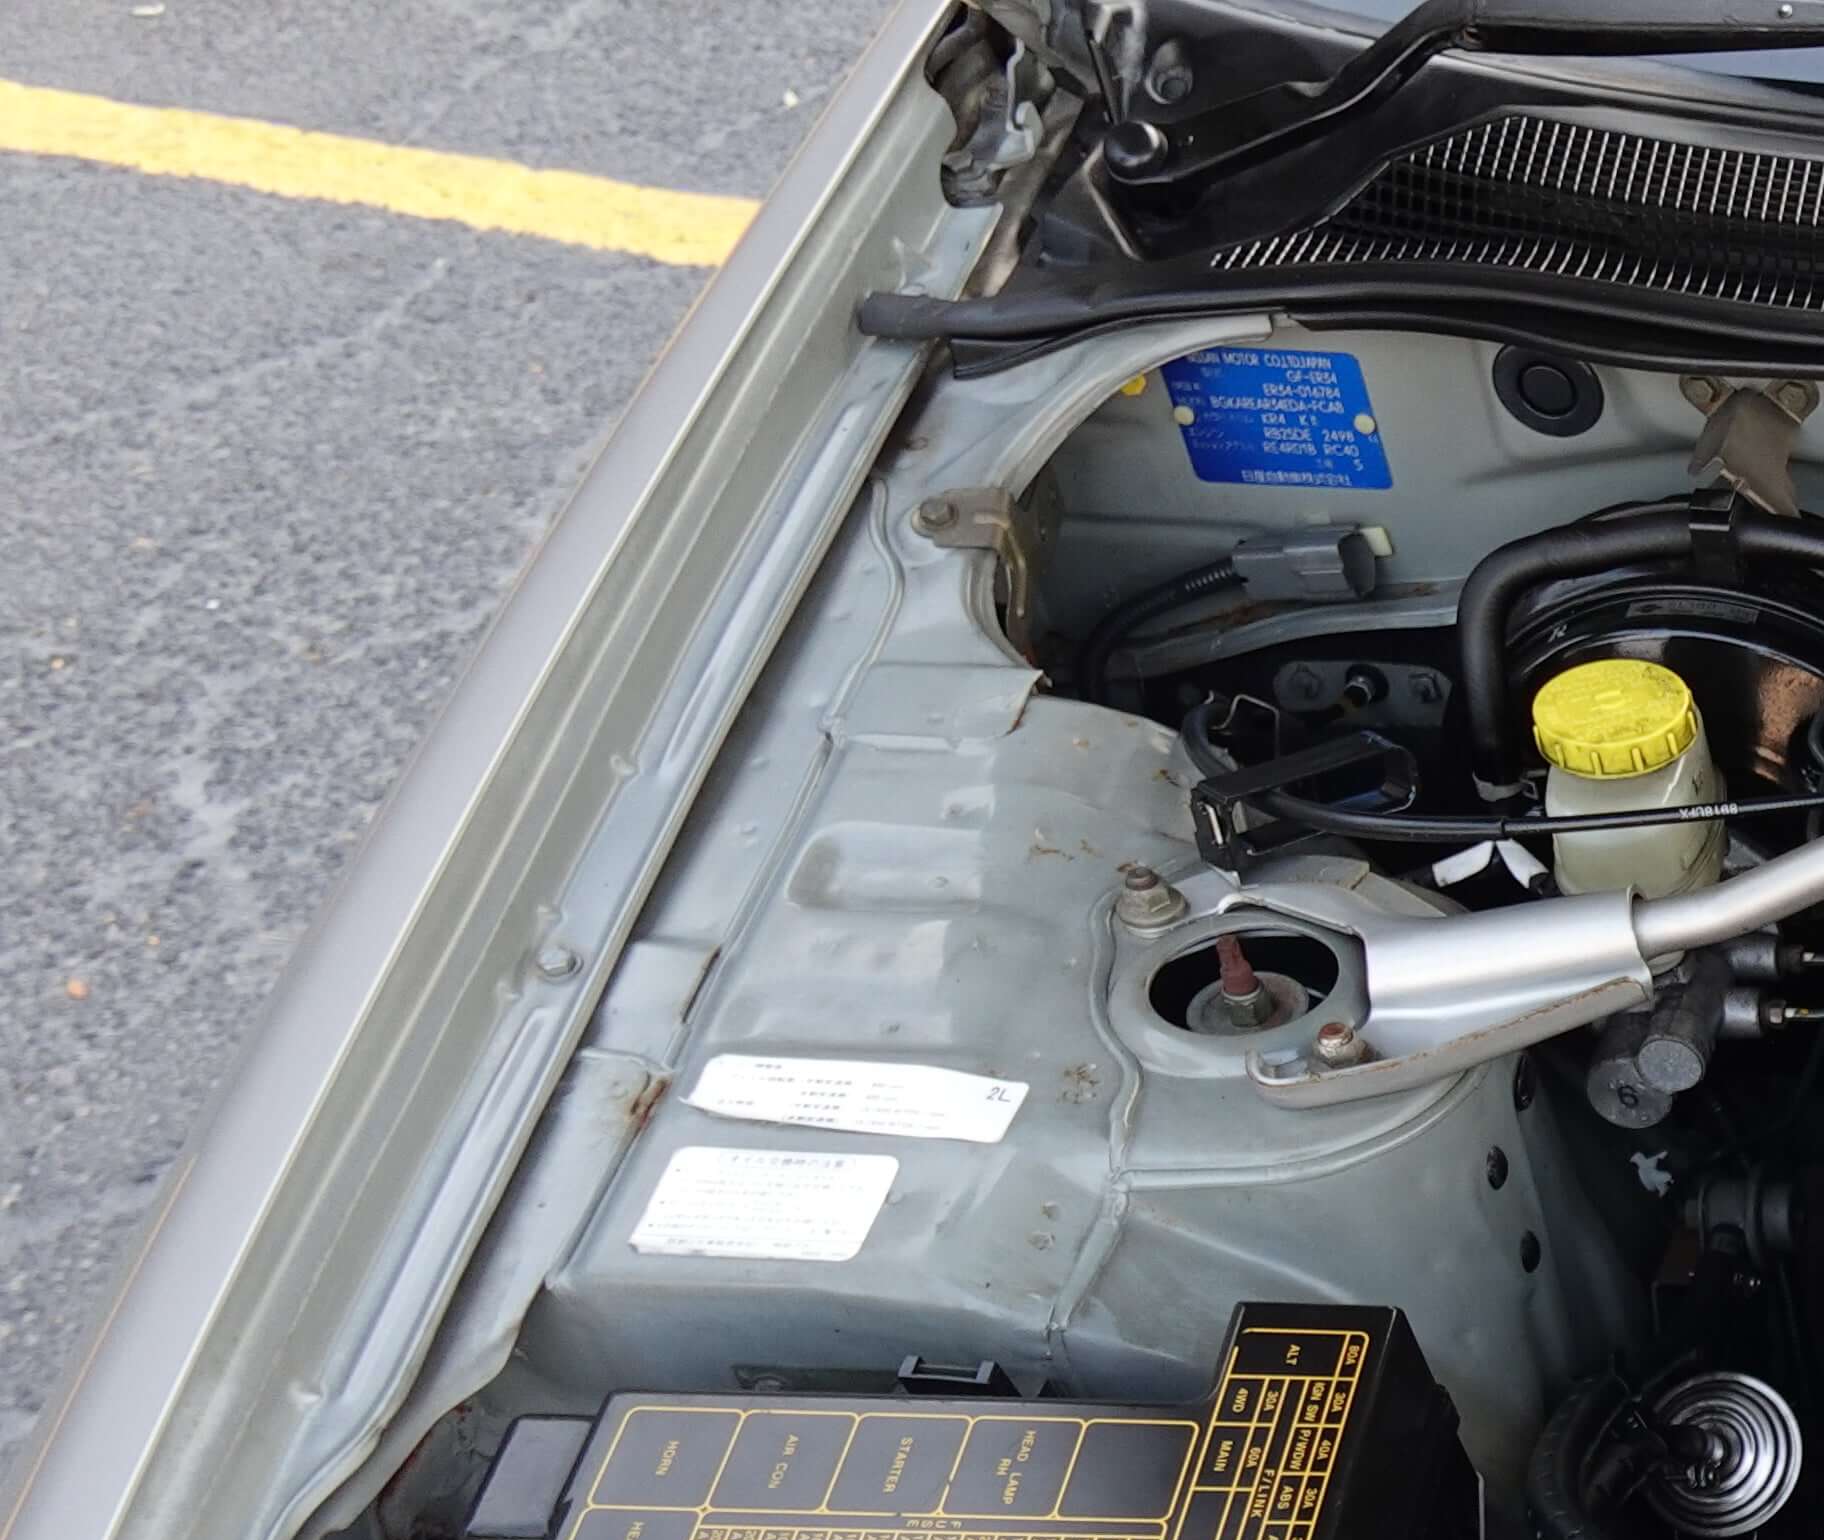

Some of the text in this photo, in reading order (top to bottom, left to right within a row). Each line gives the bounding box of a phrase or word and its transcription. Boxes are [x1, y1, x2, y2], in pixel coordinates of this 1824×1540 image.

[1286, 1344, 1300, 1366] ALT
[1345, 1345, 1360, 1365] 80A
[1232, 1387, 1249, 1413] 4WD
[1264, 1391, 1279, 1412] 30A
[1304, 1382, 1327, 1422] IGN SW
[1331, 1393, 1346, 1413] 30A
[655, 1440, 680, 1476] HORN
[768, 1434, 799, 1488] AIR CON
[1213, 1440, 1233, 1472] MAIN
[1246, 1447, 1262, 1468] 60A
[1317, 1439, 1332, 1460] 40A
[882, 1437, 912, 1493] STARTER
[996, 1458, 1012, 1476] RH
[1002, 1430, 1037, 1504] HEAD LAMP
[1277, 1485, 1294, 1510] ABS
[1302, 1487, 1318, 1509] 30A
